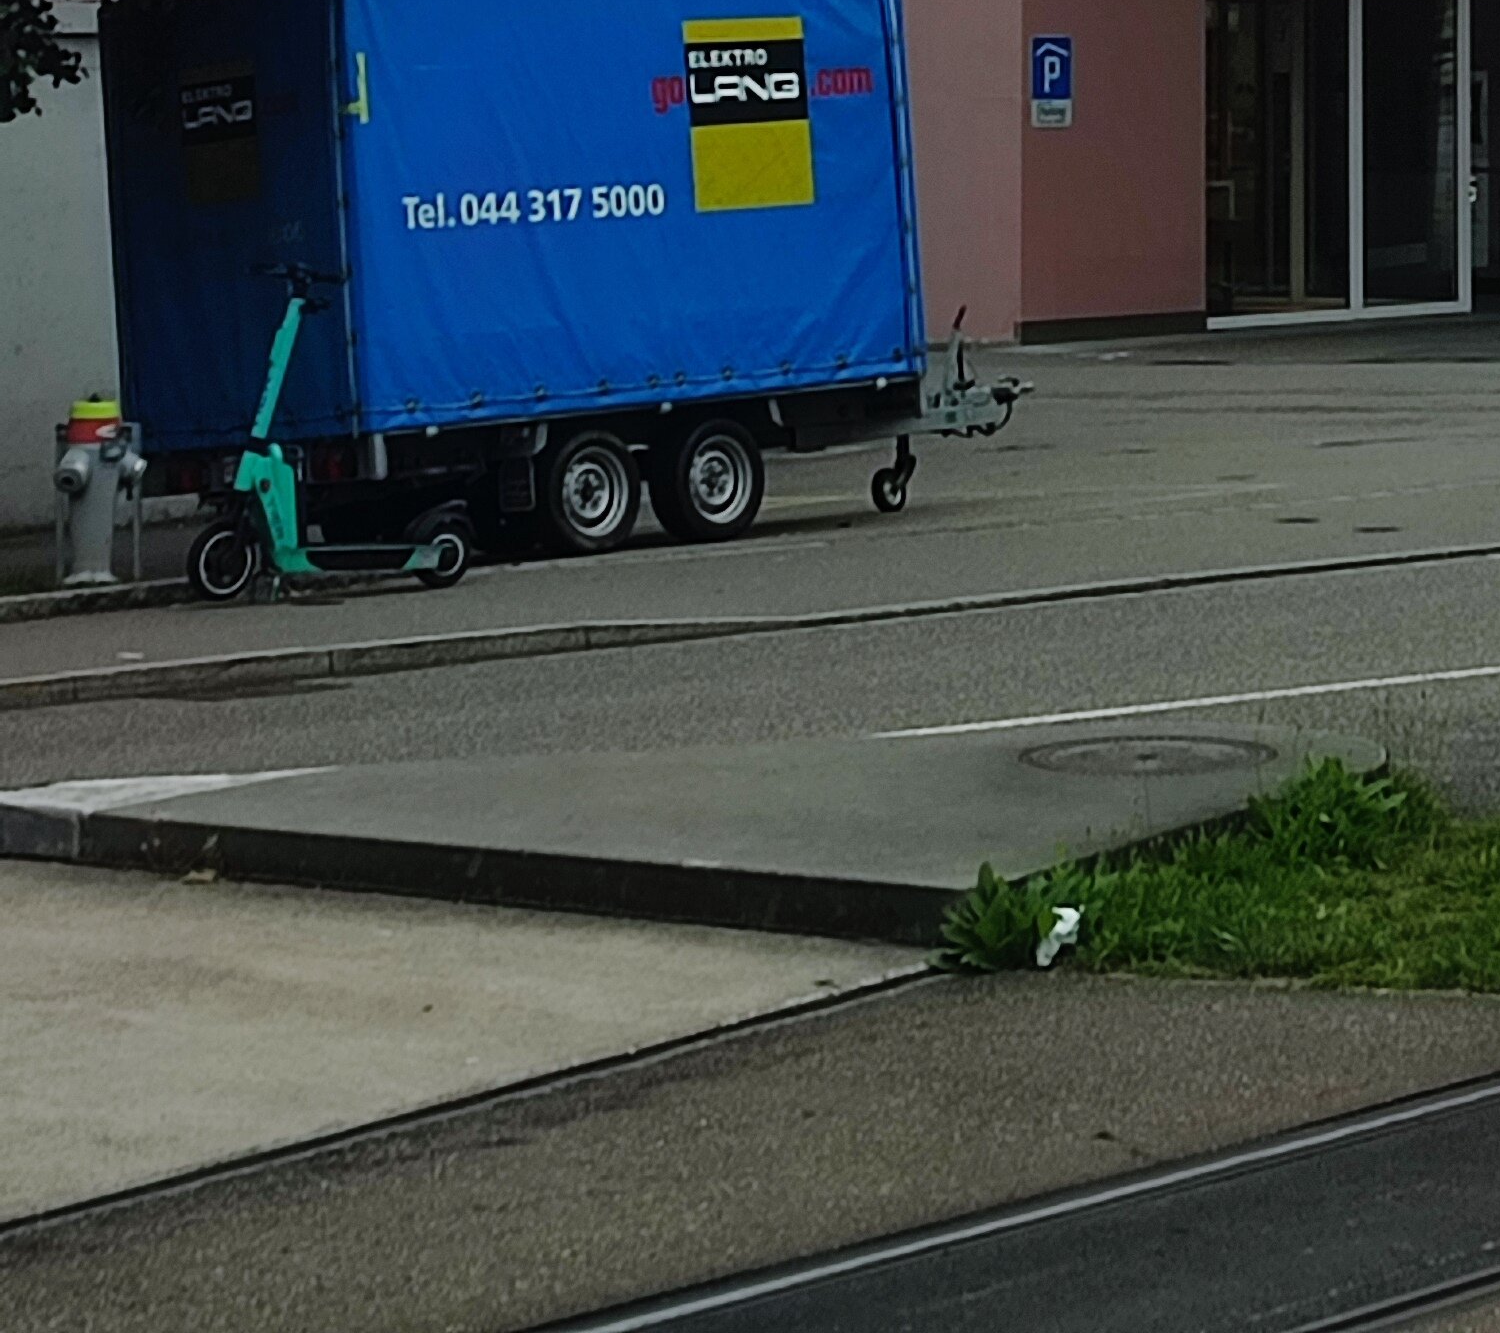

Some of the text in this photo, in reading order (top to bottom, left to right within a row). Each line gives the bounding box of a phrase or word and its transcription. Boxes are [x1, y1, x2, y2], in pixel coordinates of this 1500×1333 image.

[688, 48, 768, 69] ELEKTRO
[1044, 56, 1061, 93] P
[651, 75, 684, 117] go
[689, 72, 800, 104] LANG
[402, 183, 665, 230] Tel. 044 317 5000
